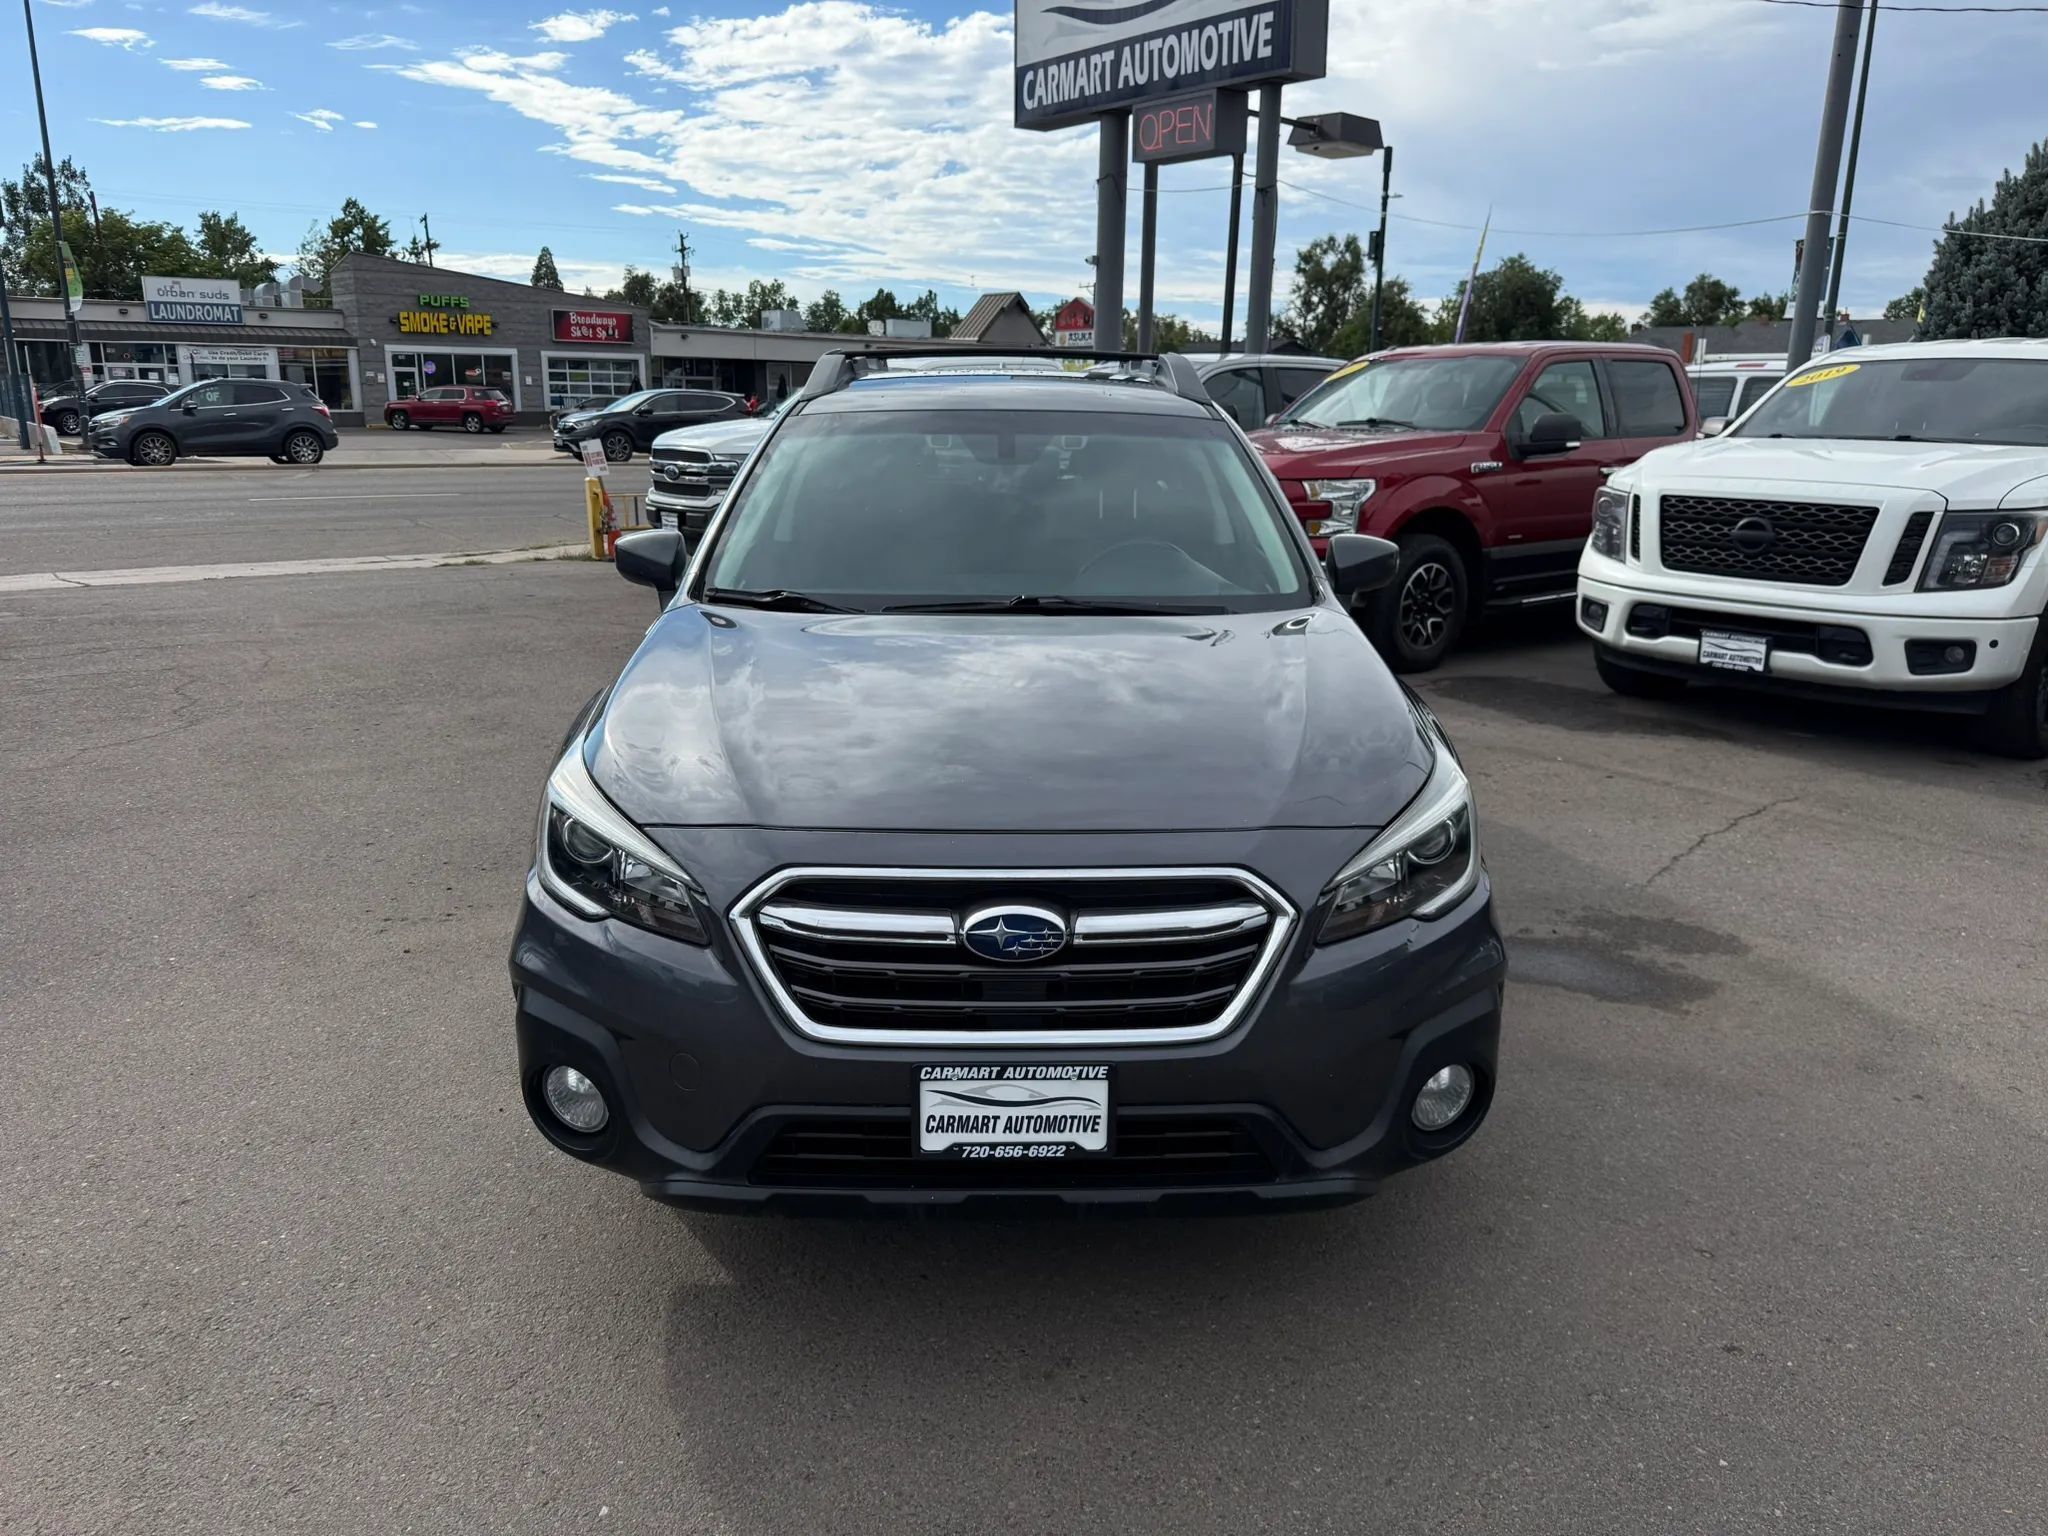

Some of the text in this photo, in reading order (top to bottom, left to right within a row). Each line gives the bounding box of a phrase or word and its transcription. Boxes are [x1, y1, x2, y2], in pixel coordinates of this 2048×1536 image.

[1023, 10, 1274, 110] CARMART AUTOMOTIVE
[1139, 103, 1213, 153] OPEN
[199, 287, 230, 300] suds
[419, 294, 470, 309] PUFFS
[150, 303, 239, 322] LAUNDROMAT
[399, 311, 492, 336] SMOKE & VAPE
[1703, 650, 1728, 659] CARMART
[920, 1065, 1109, 1080] CARMART AUTOMOTIVE
[925, 1114, 1102, 1134] CARMART AUTOMOTIVE
[961, 1145, 1067, 1158] 720-656-6922
